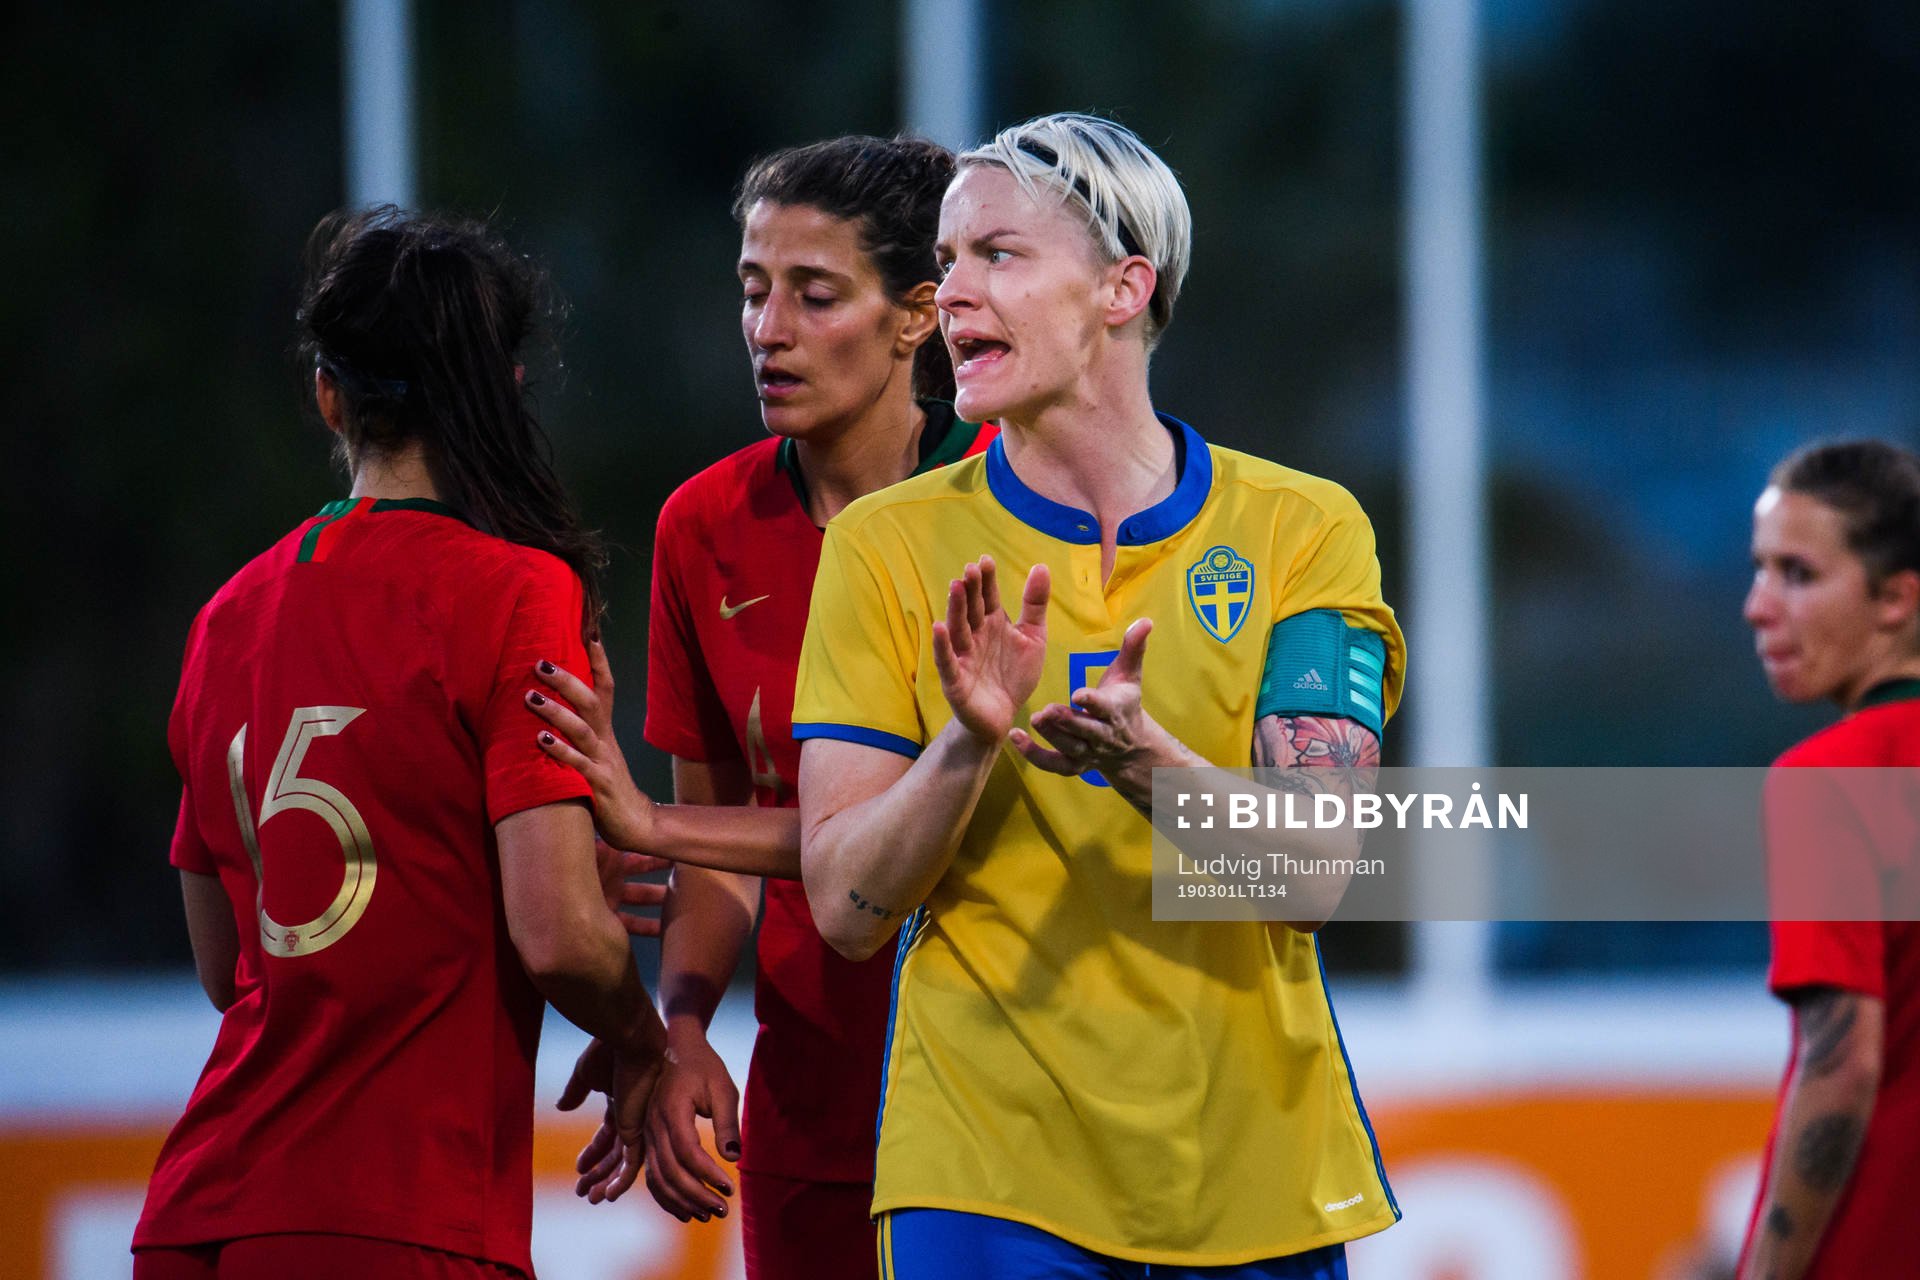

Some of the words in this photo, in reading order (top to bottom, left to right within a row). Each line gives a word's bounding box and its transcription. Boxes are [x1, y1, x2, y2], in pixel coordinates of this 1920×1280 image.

[1200, 572, 1243, 582] SVERIGE
[1293, 680, 1328, 691] adidas
[226, 705, 378, 958] 15
